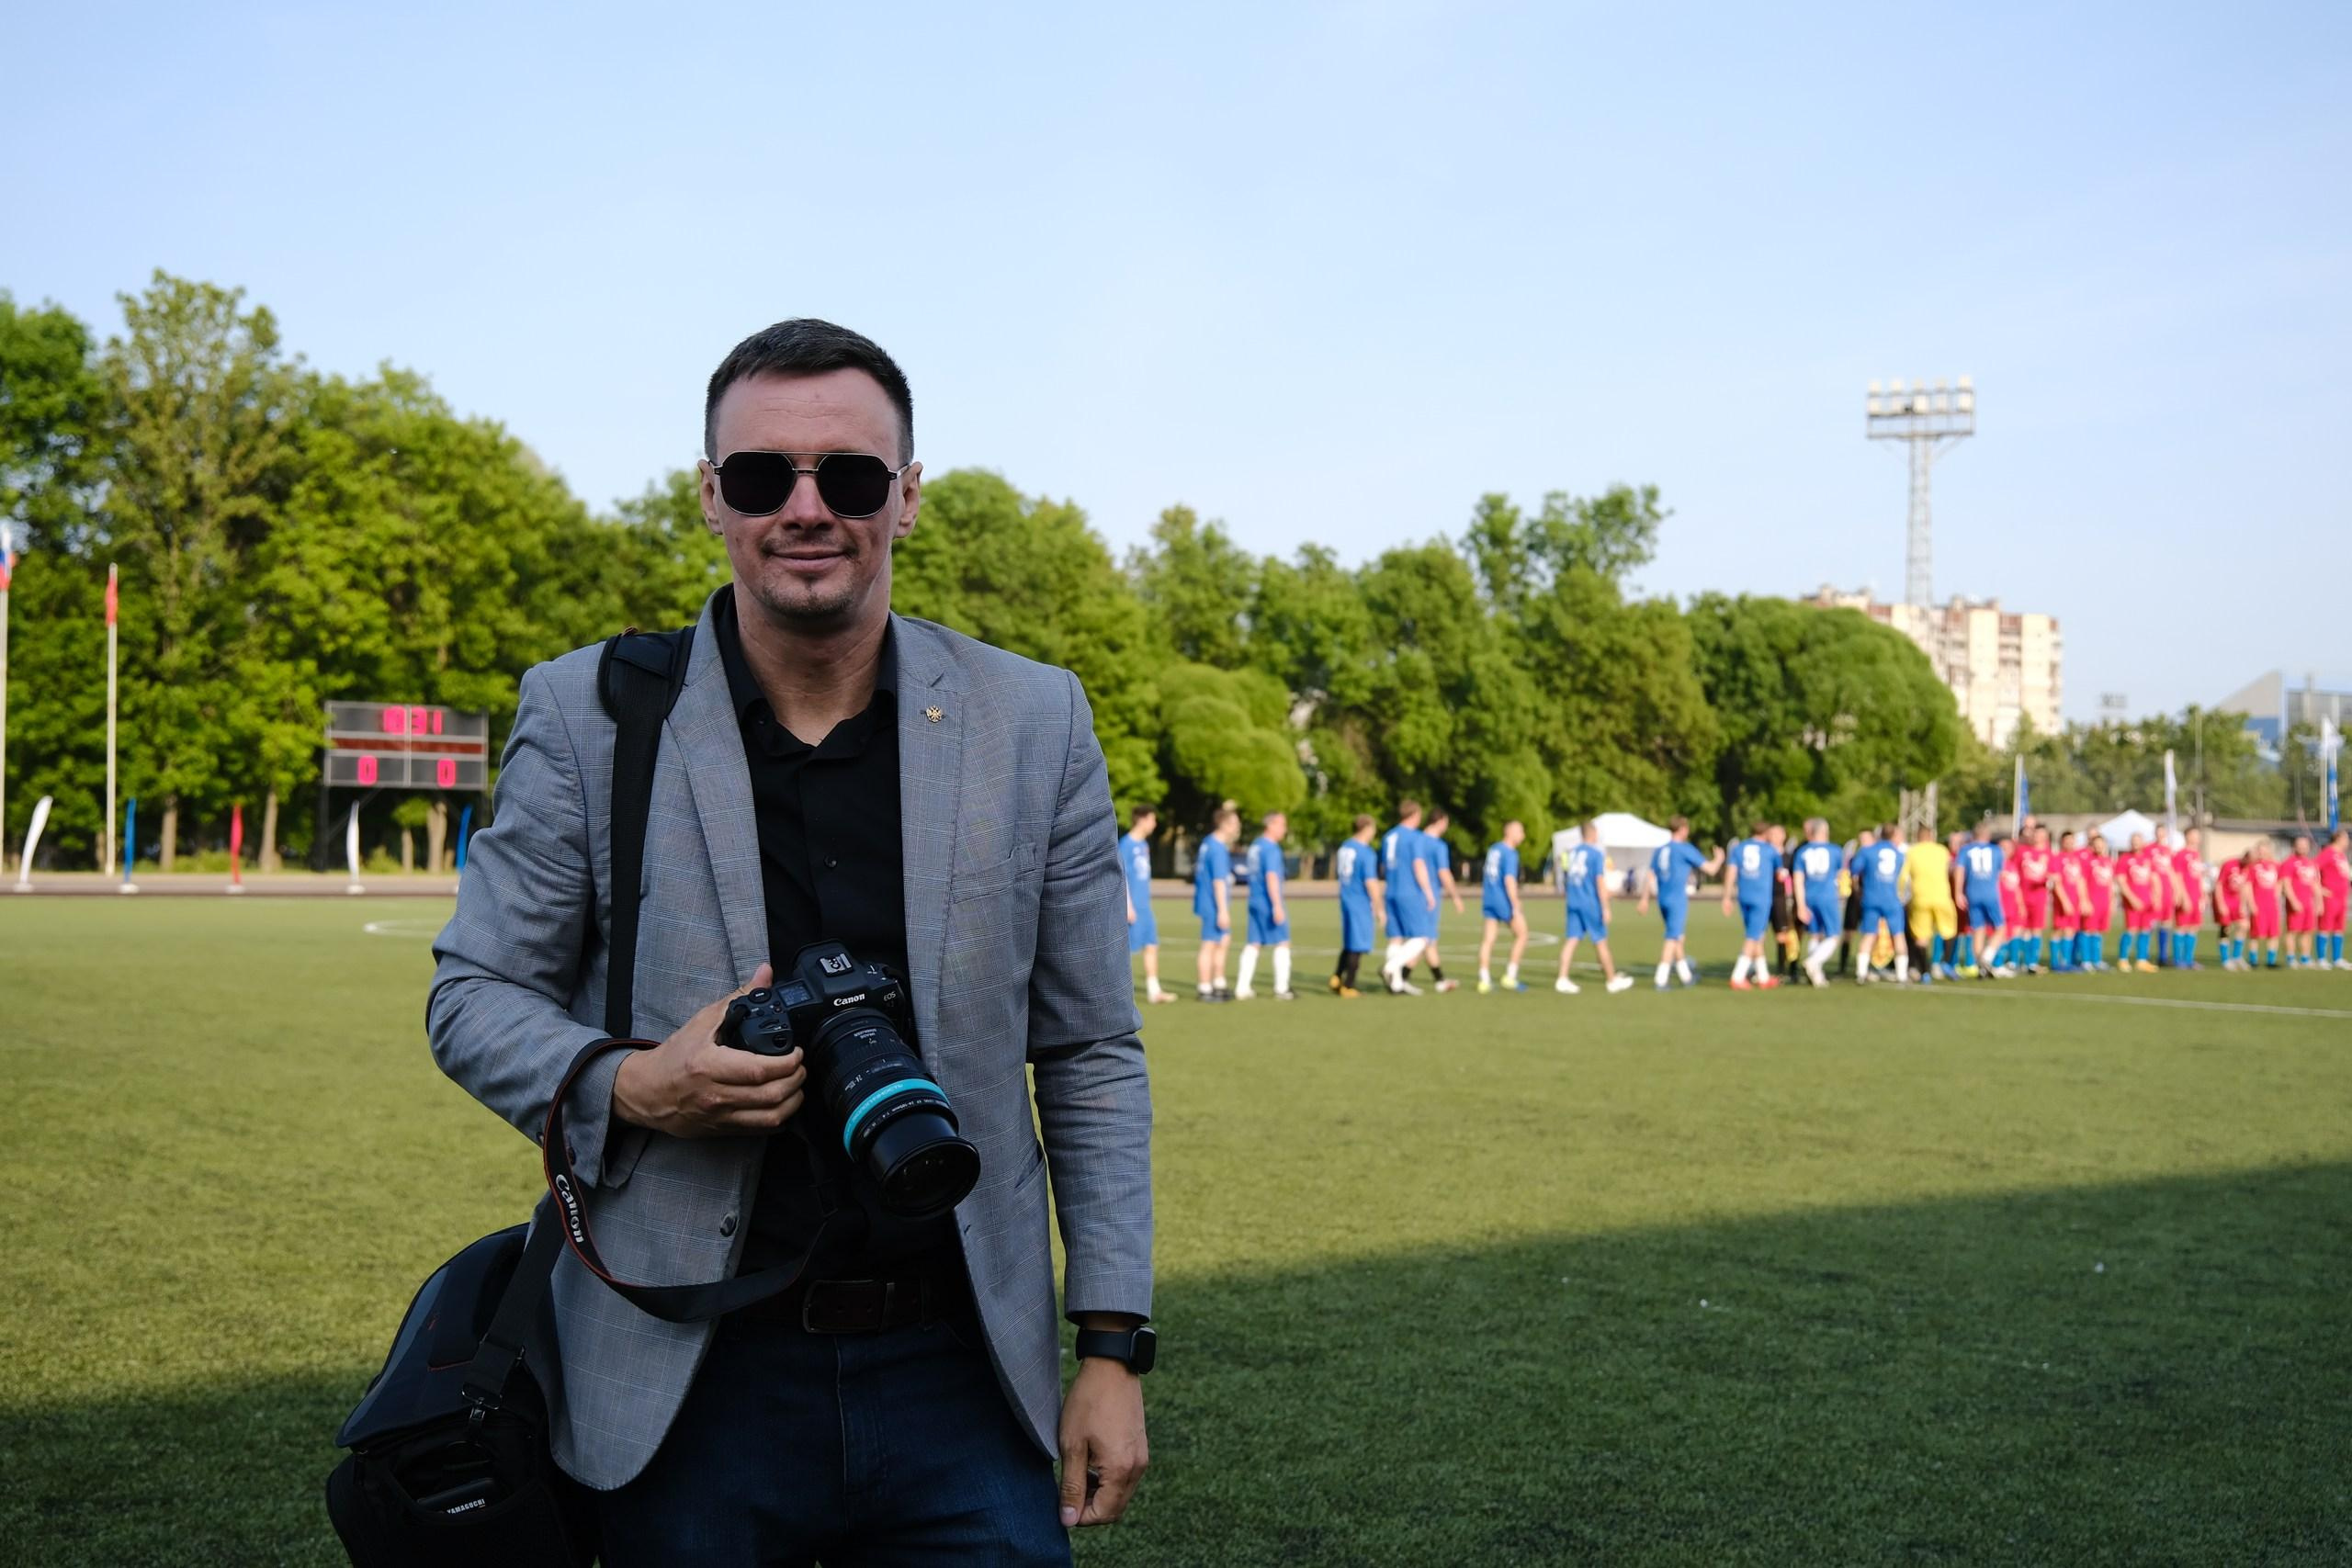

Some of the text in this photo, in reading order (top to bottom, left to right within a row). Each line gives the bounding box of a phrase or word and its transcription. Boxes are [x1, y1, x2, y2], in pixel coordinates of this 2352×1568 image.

[357, 755, 378, 784] 0
[436, 758, 457, 787] 0
[1801, 846, 1830, 875] 10
[1878, 847, 1897, 875] 3
[1967, 845, 1993, 874] 11
[832, 993, 865, 1007] Canon
[883, 991, 897, 1002] EOS
[556, 1174, 584, 1243] Canon
[446, 1498, 486, 1514] YAMAGUCHI
